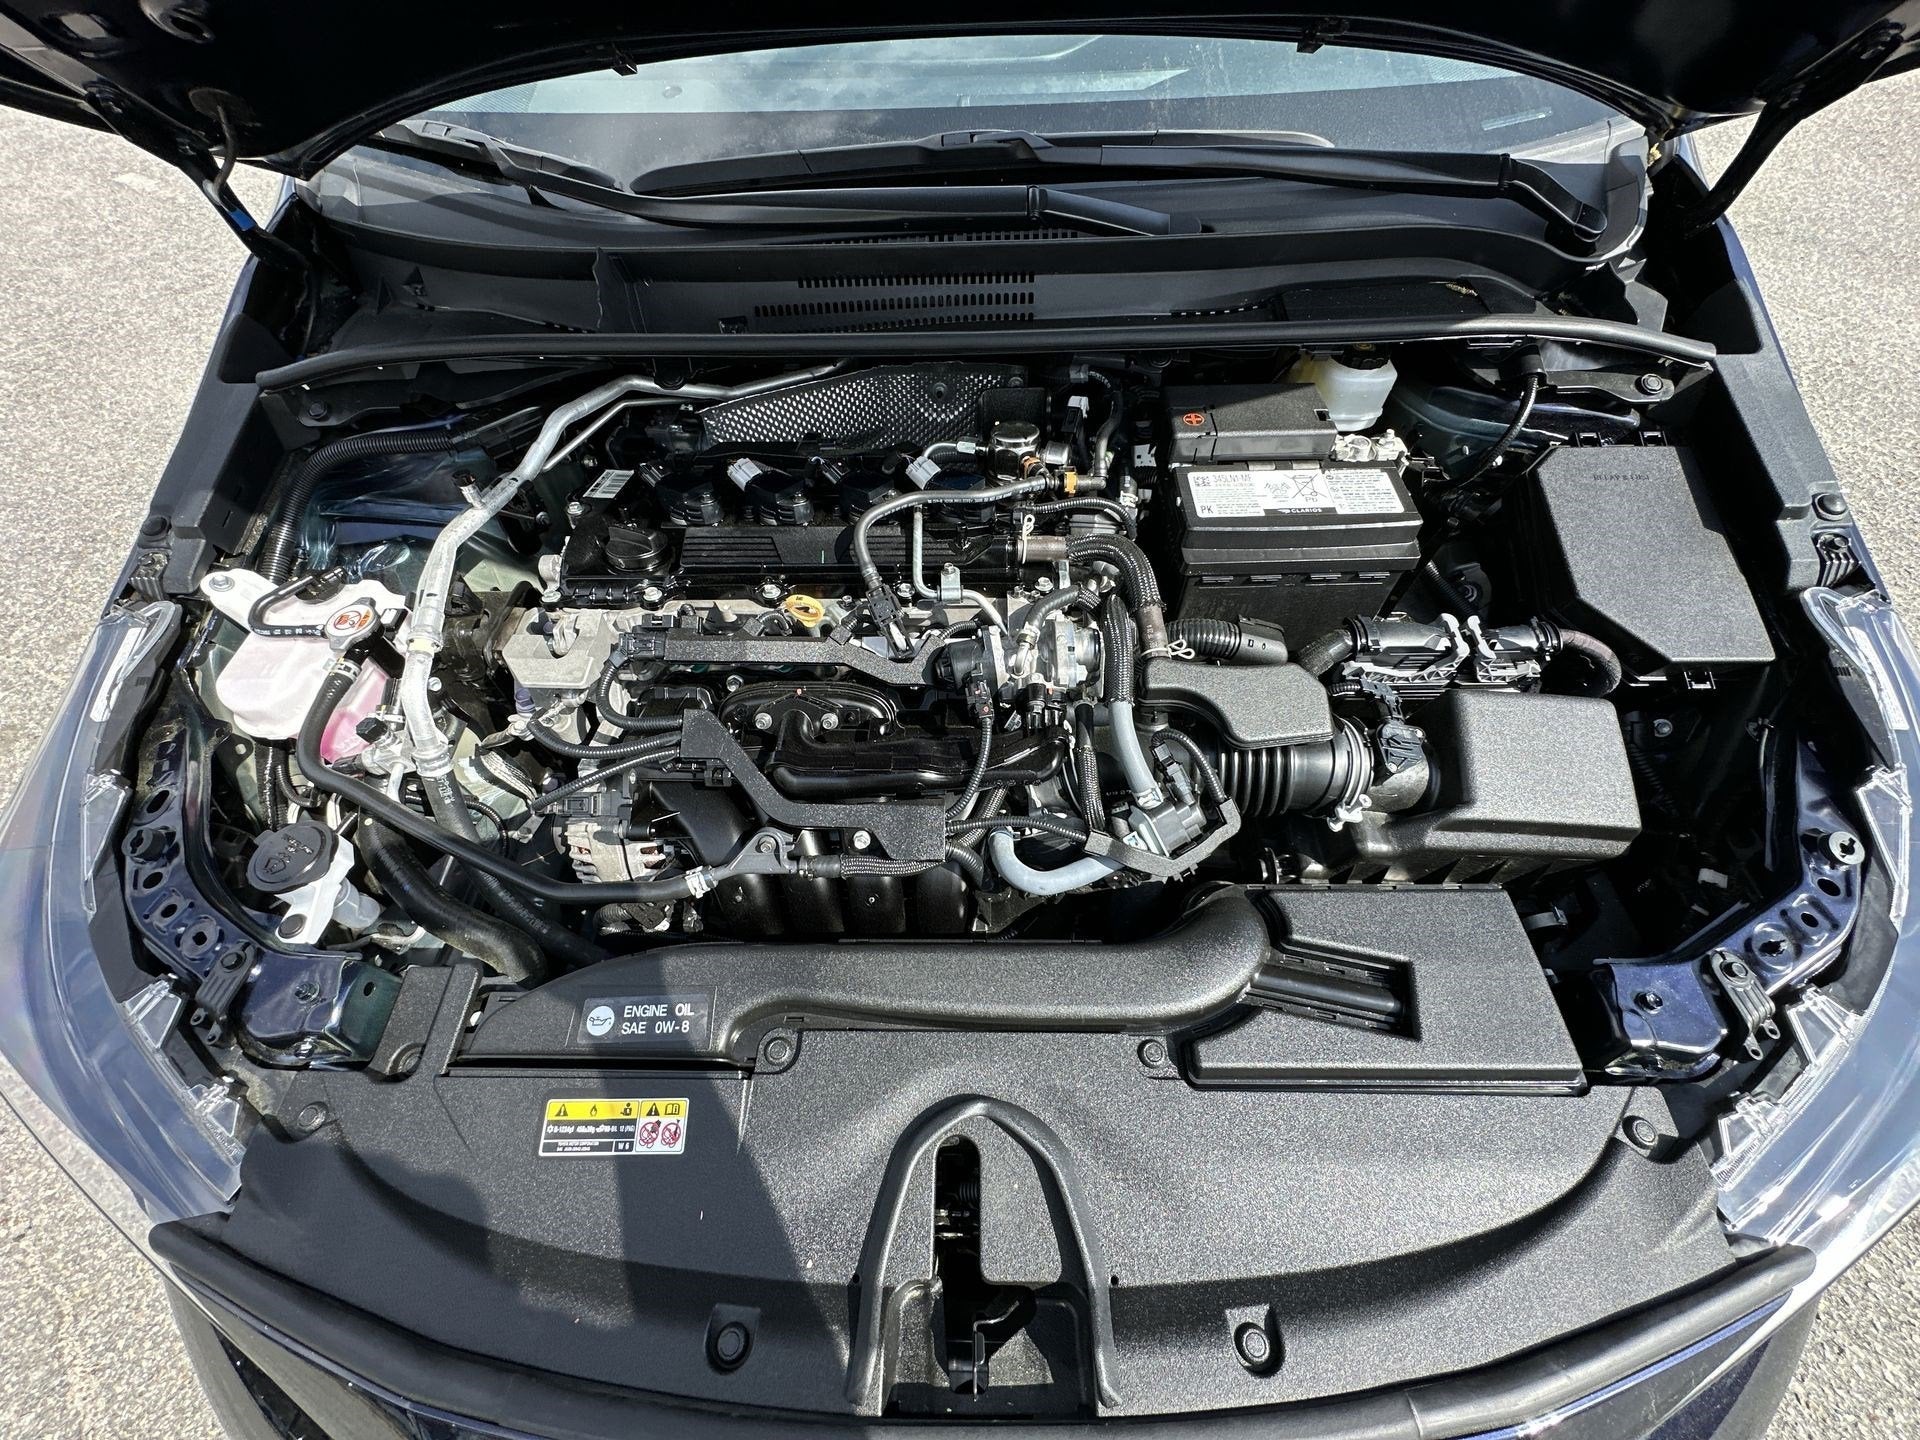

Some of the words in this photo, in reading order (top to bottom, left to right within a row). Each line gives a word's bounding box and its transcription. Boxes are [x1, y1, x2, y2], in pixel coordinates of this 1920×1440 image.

[1200, 505, 1214, 514] PK
[624, 1004, 668, 1018] ENGINE
[675, 1003, 695, 1016] OIL
[621, 1022, 647, 1035] SAE
[655, 1020, 690, 1033] 0W-8
